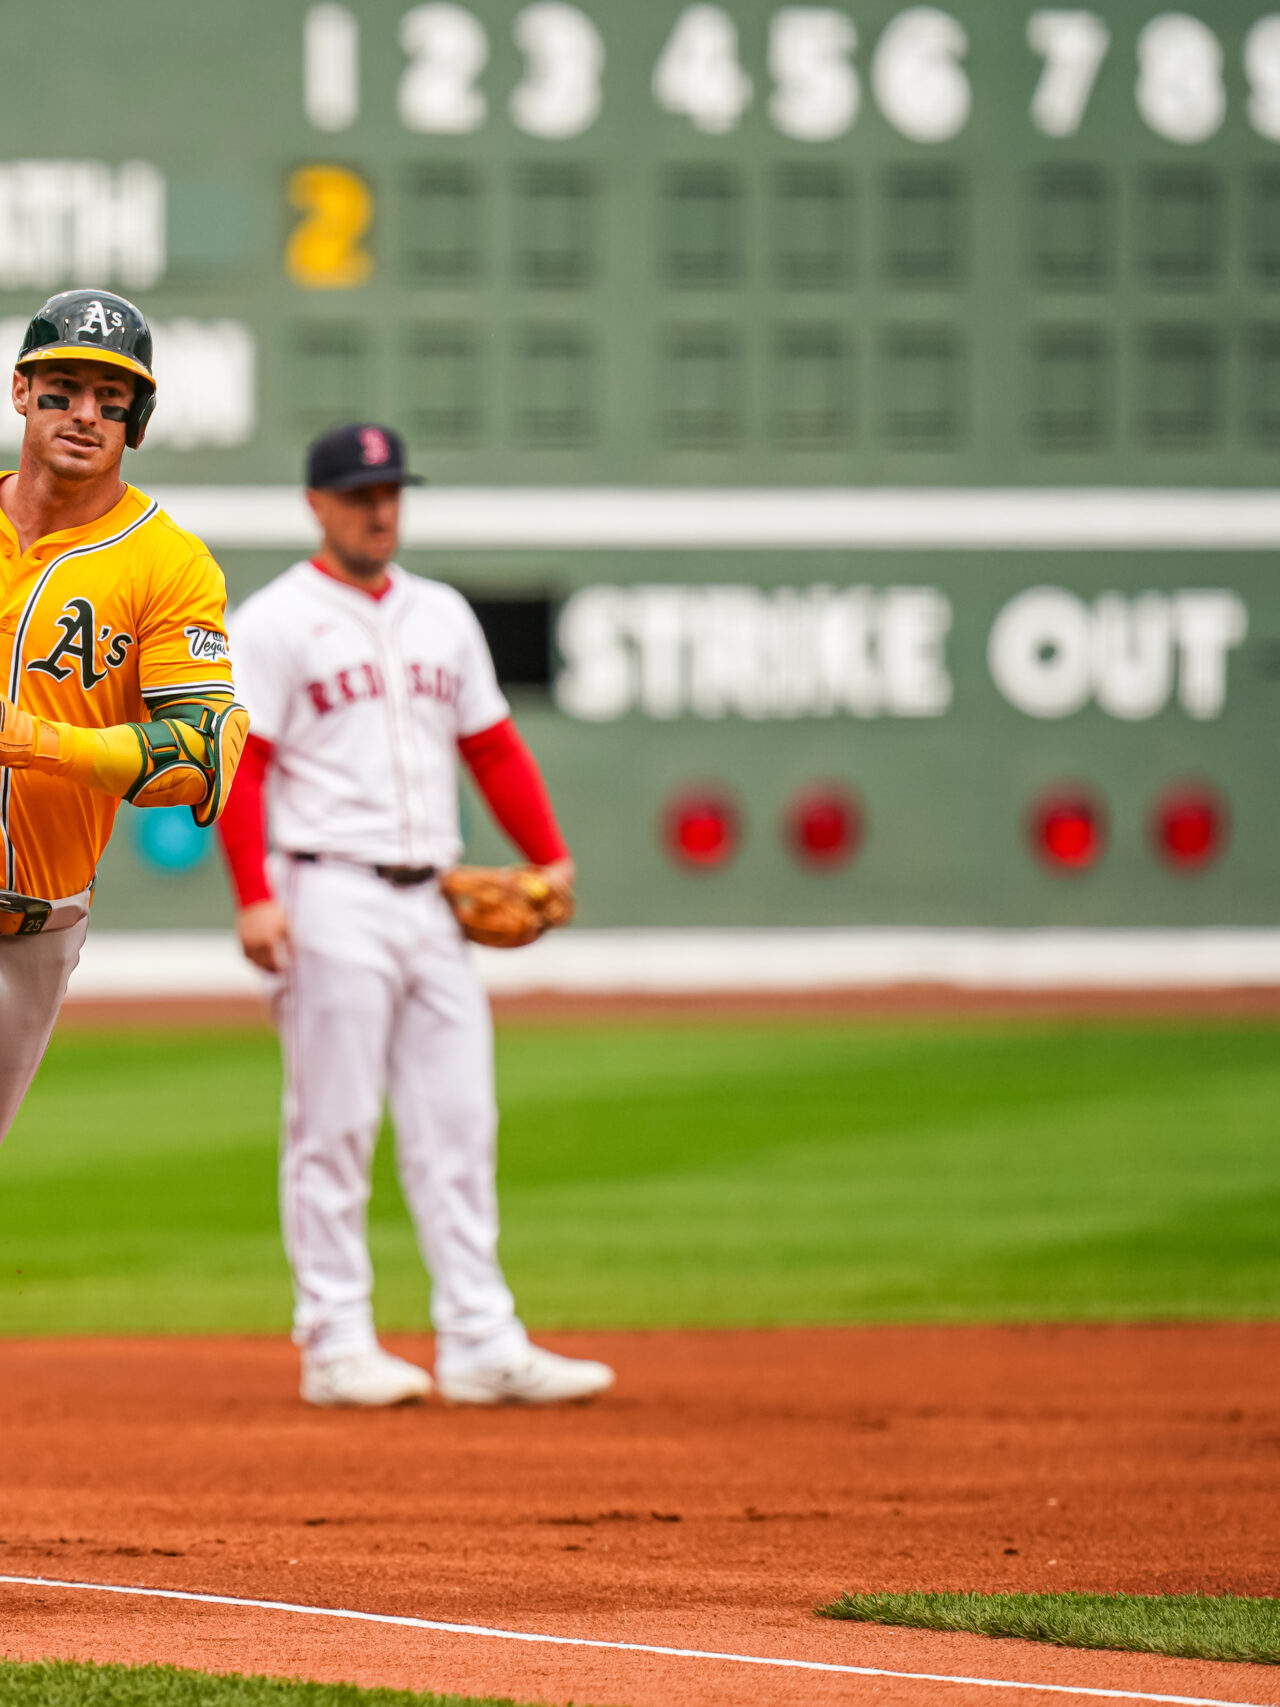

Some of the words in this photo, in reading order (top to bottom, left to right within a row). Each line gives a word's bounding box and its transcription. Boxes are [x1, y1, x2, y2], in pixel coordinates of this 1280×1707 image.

[397, 2, 489, 134] 2
[509, 0, 605, 139] 3
[652, 1, 753, 135] 4
[767, 5, 861, 142] 5
[872, 6, 972, 143] 6
[1027, 9, 1111, 138] 7
[1136, 13, 1226, 144] 8
[284, 162, 376, 290] 2
[76, 300, 123, 336] A's
[26, 597, 134, 691] A's
[556, 583, 952, 722] STRIKE
[988, 586, 1248, 720] OUT
[25, 919, 42, 932] 25
